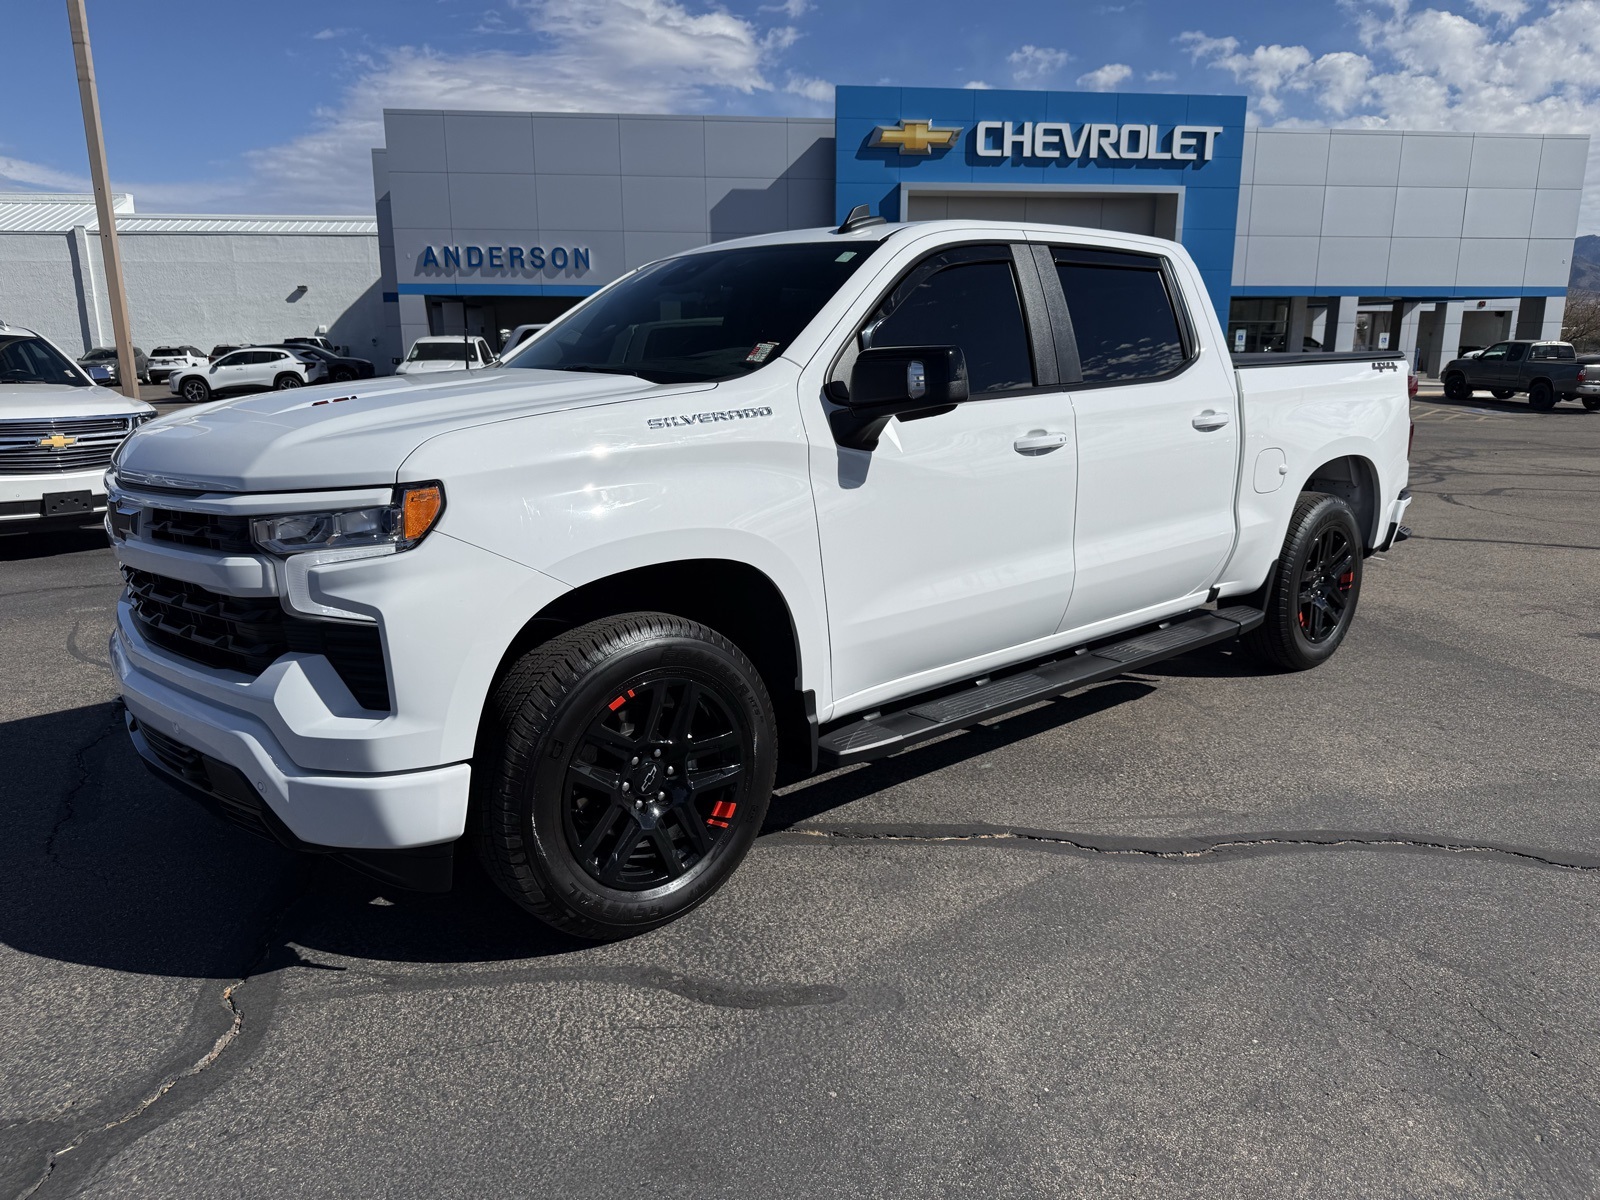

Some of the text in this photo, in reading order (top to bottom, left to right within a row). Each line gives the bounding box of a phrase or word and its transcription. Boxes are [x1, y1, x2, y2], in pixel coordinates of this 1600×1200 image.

[975, 120, 1224, 162] CHEVROLET
[423, 245, 591, 271] ANDERSON
[647, 405, 773, 430] SILVERADO
